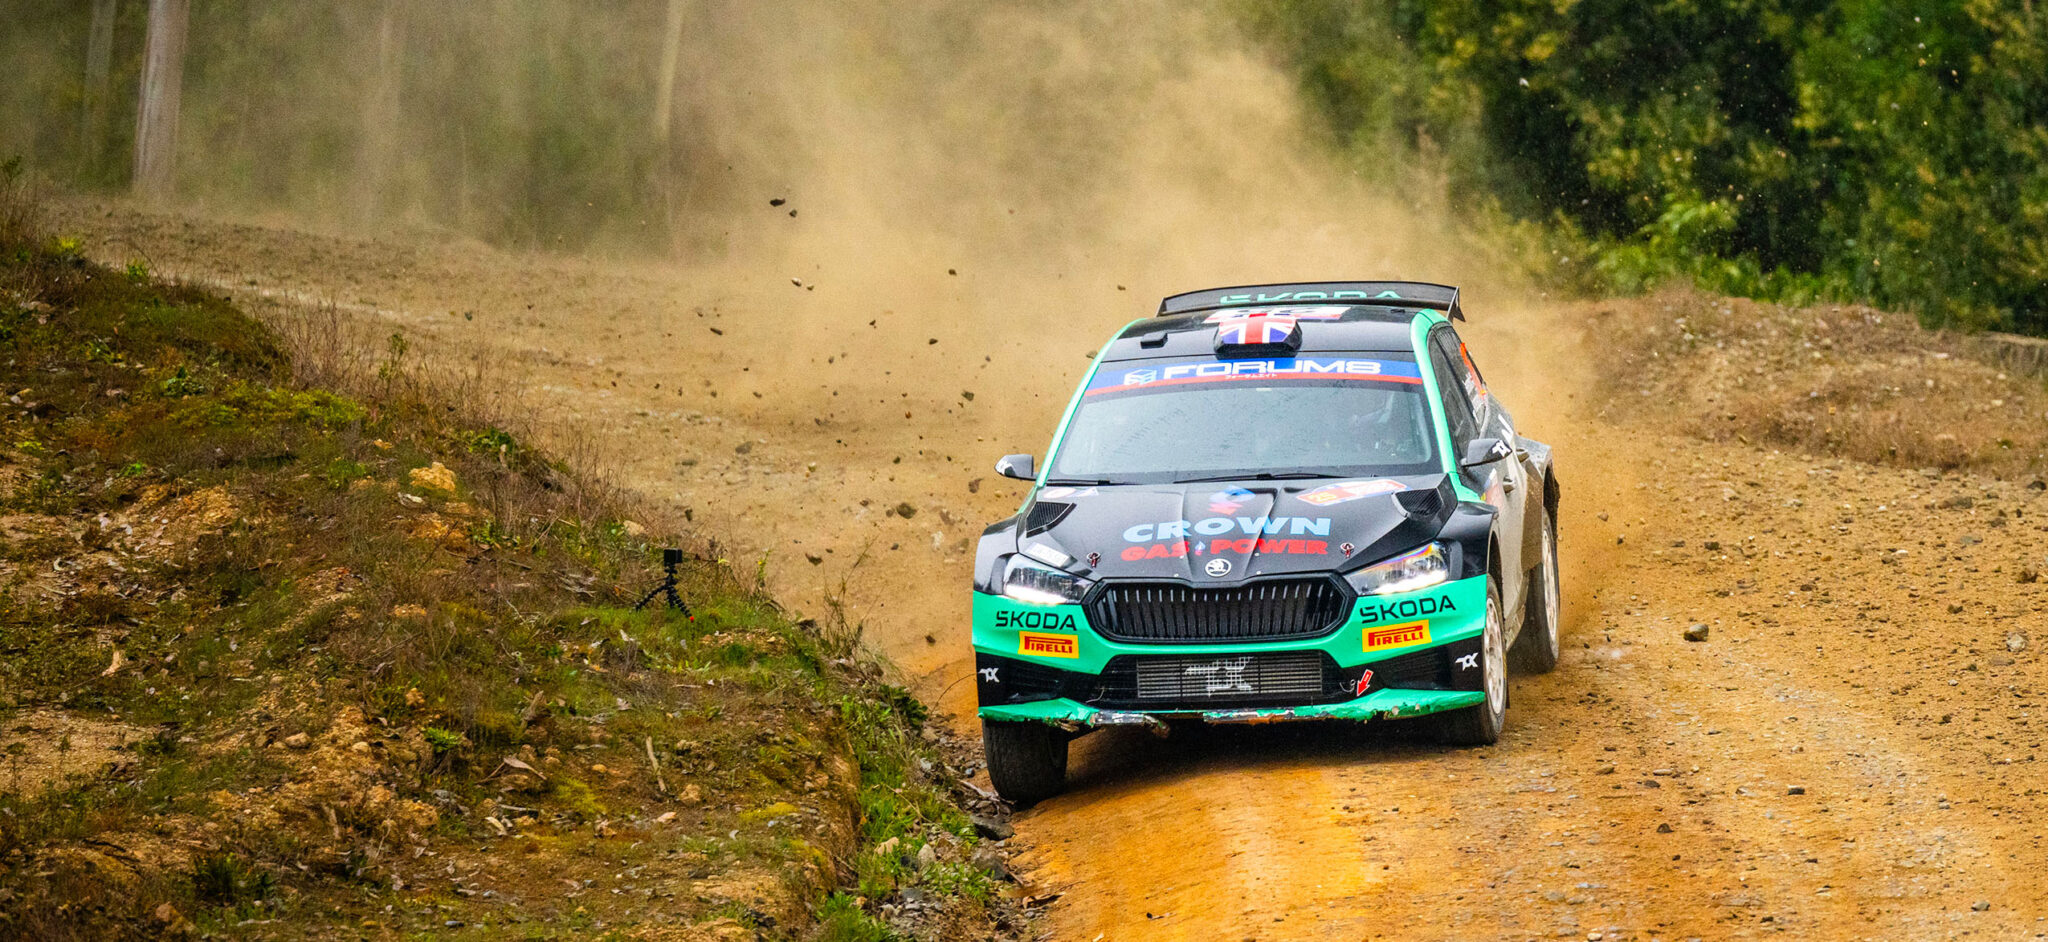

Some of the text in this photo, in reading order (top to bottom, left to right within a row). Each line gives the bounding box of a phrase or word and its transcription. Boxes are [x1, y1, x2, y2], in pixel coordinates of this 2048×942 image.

[1163, 360, 1382, 380] FORUM8
[1123, 517, 1332, 543] CROWN
[1121, 537, 1329, 561] GAS POWER
[1024, 635, 1073, 654] PIRELLI
[1368, 625, 1424, 647] PIRELLI
